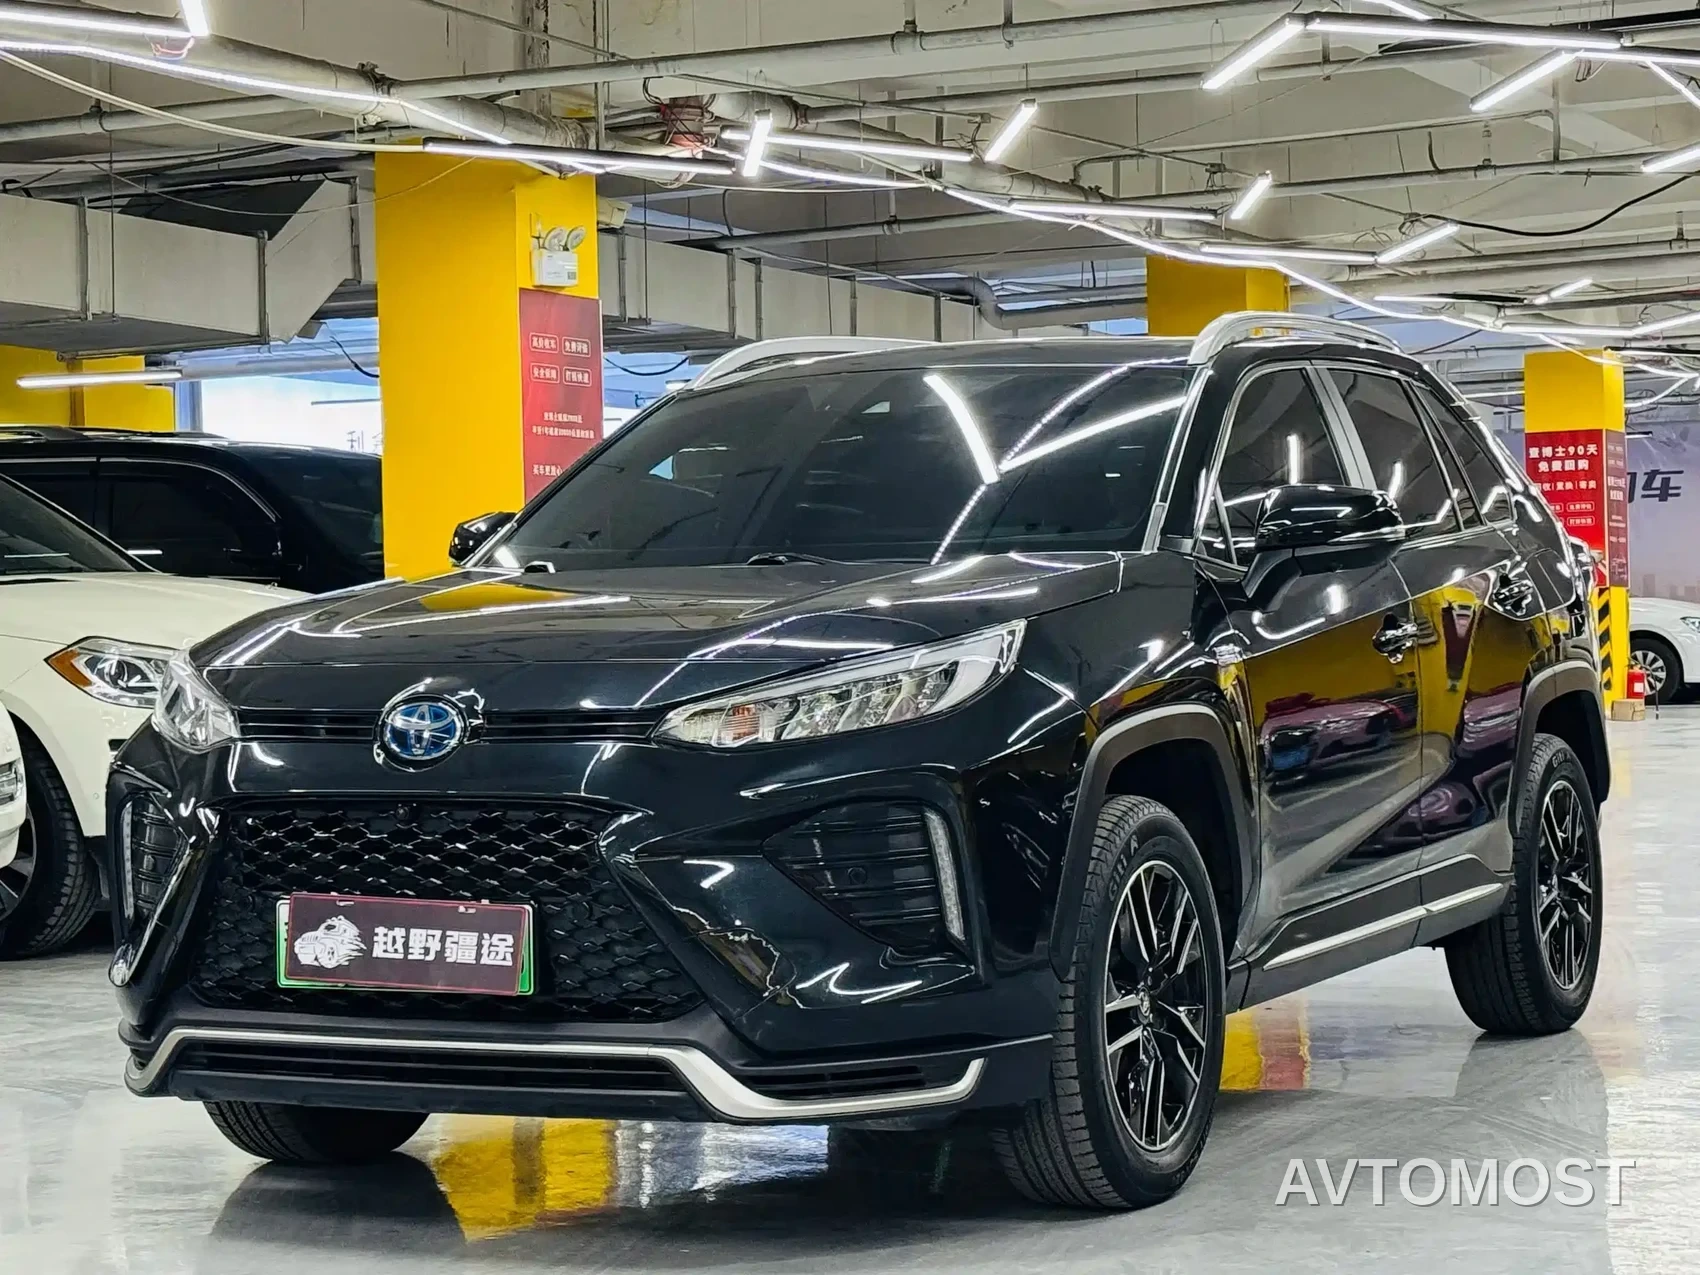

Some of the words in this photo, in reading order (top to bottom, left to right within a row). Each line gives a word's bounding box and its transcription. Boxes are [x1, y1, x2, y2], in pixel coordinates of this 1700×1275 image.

[1538, 459, 1589, 472] 免费回购
[372, 926, 514, 966] 越野疆途
